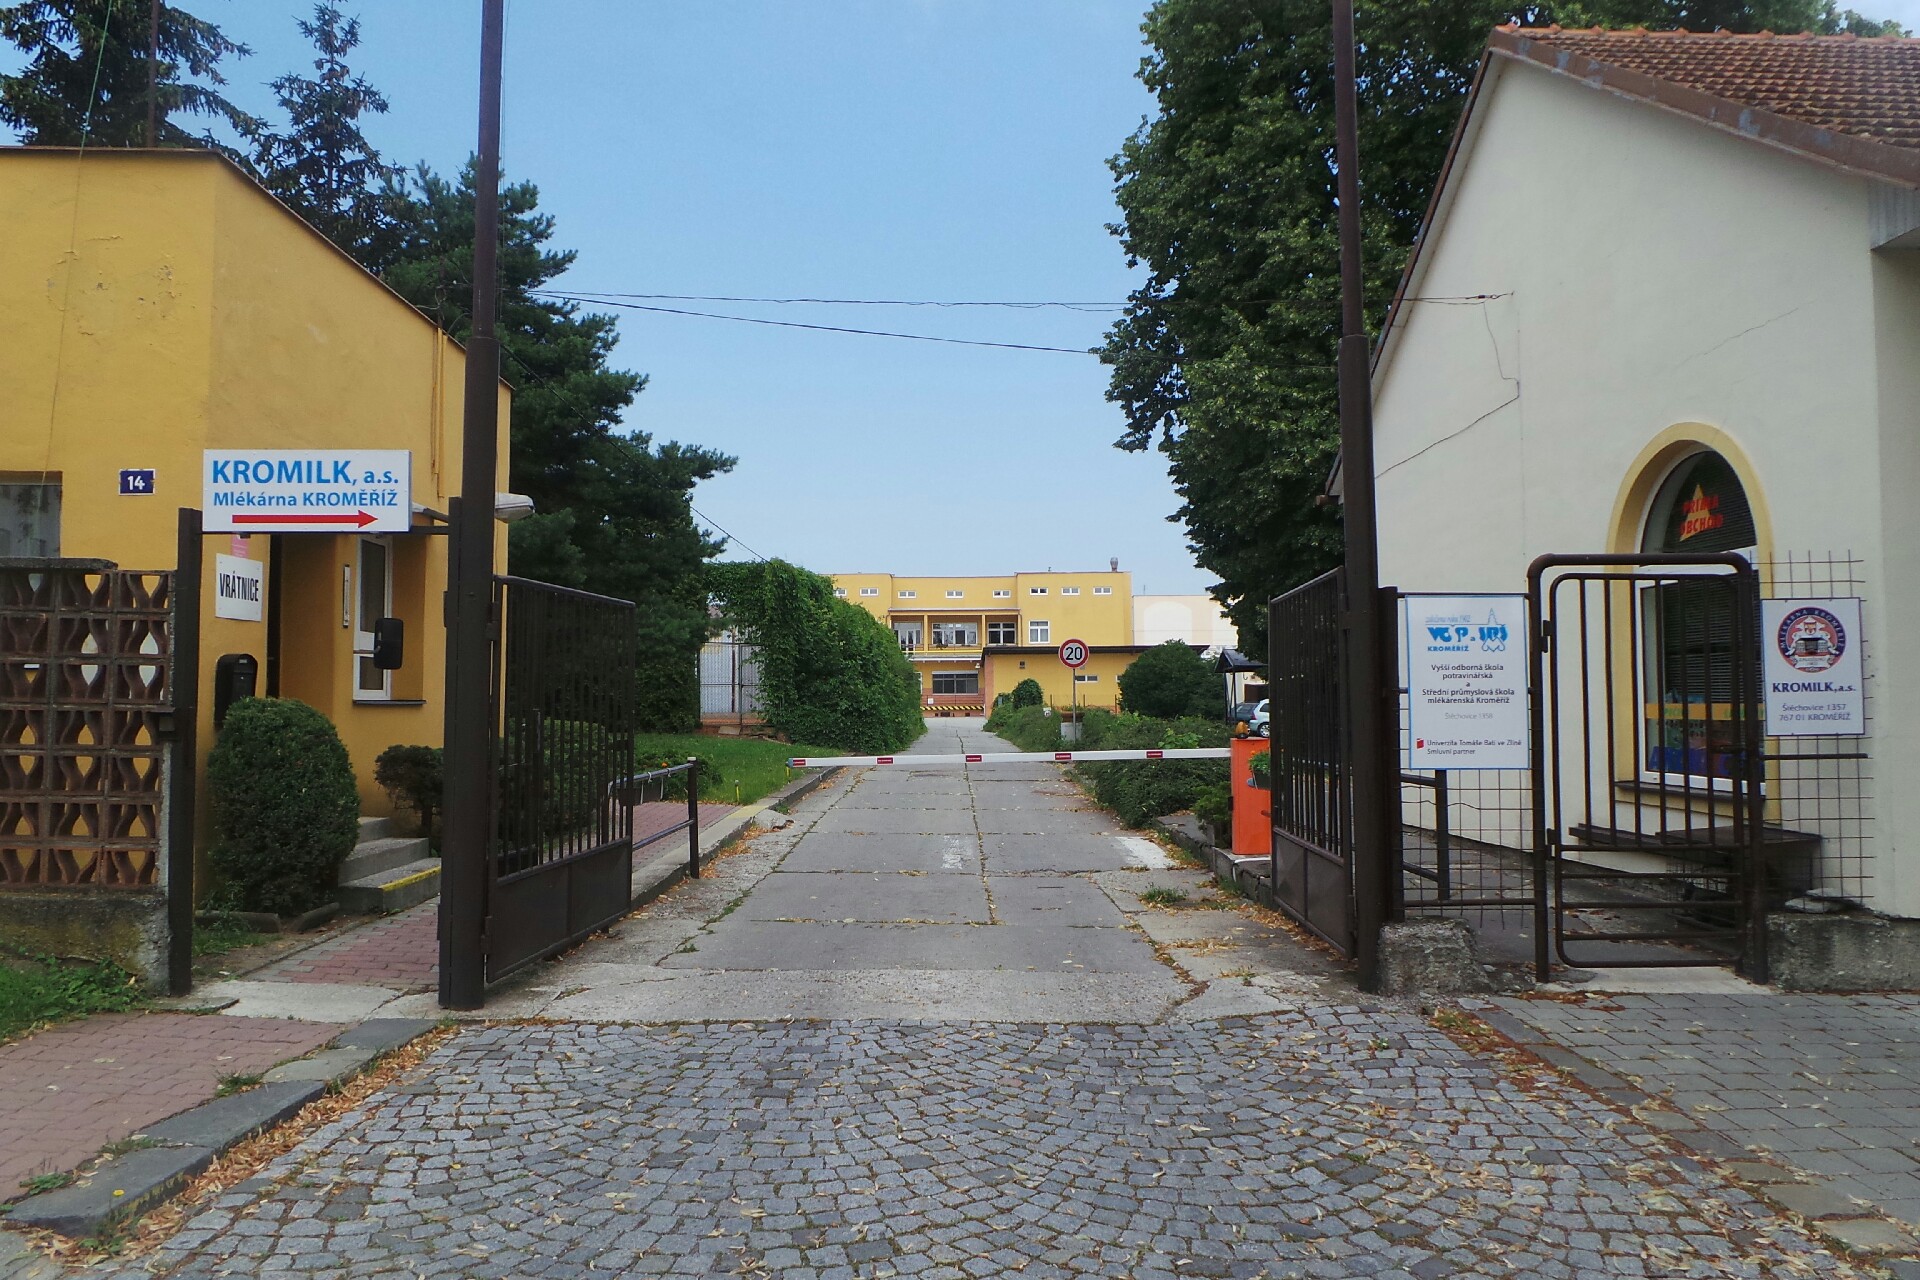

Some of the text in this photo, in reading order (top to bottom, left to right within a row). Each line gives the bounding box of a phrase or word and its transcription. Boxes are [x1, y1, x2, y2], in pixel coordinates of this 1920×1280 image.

[212, 460, 399, 486] KROMILK, a.s.
[127, 475, 146, 490] 14
[213, 488, 399, 507] Mlékárna KROMĚŘÍŽ
[219, 570, 260, 602] VRÁTNICE
[1065, 646, 1083, 661] 20
[1431, 664, 1504, 673] Vyšší odborná škola
[1442, 672, 1493, 680] potravinářská
[1422, 688, 1515, 697] Střední průmyslová škola
[1427, 696, 1510, 704] mlékárenská Kroměříž
[1827, 703, 1847, 711] 1357
